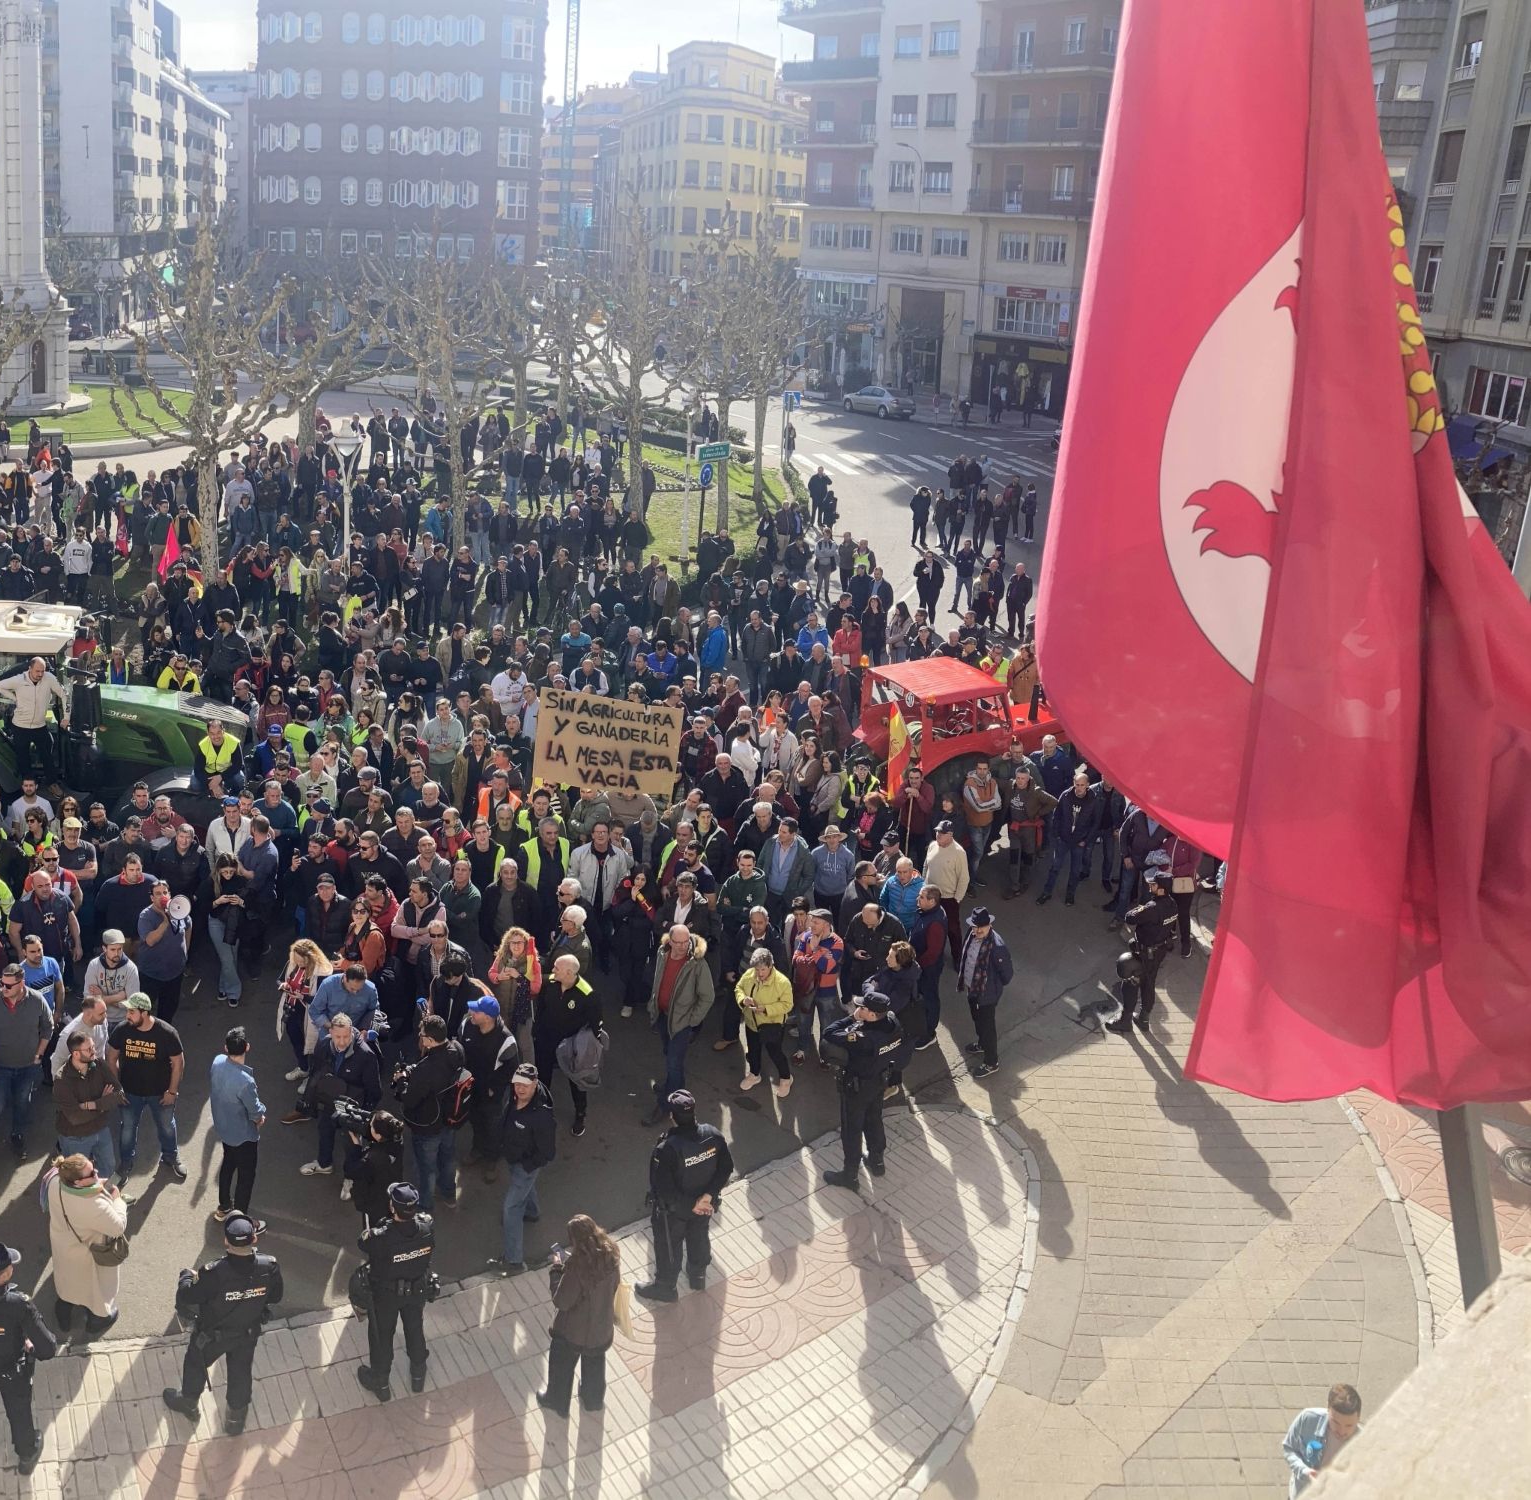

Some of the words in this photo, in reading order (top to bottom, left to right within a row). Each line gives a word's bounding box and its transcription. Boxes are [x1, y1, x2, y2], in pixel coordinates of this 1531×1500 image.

[554, 716, 570, 736] Y
[546, 740, 568, 766] LA
[576, 746, 624, 769] MESA
[629, 750, 674, 772] ESTA
[126, 1038, 156, 1048] G-STAR
[394, 1250, 422, 1258] POLICIA
